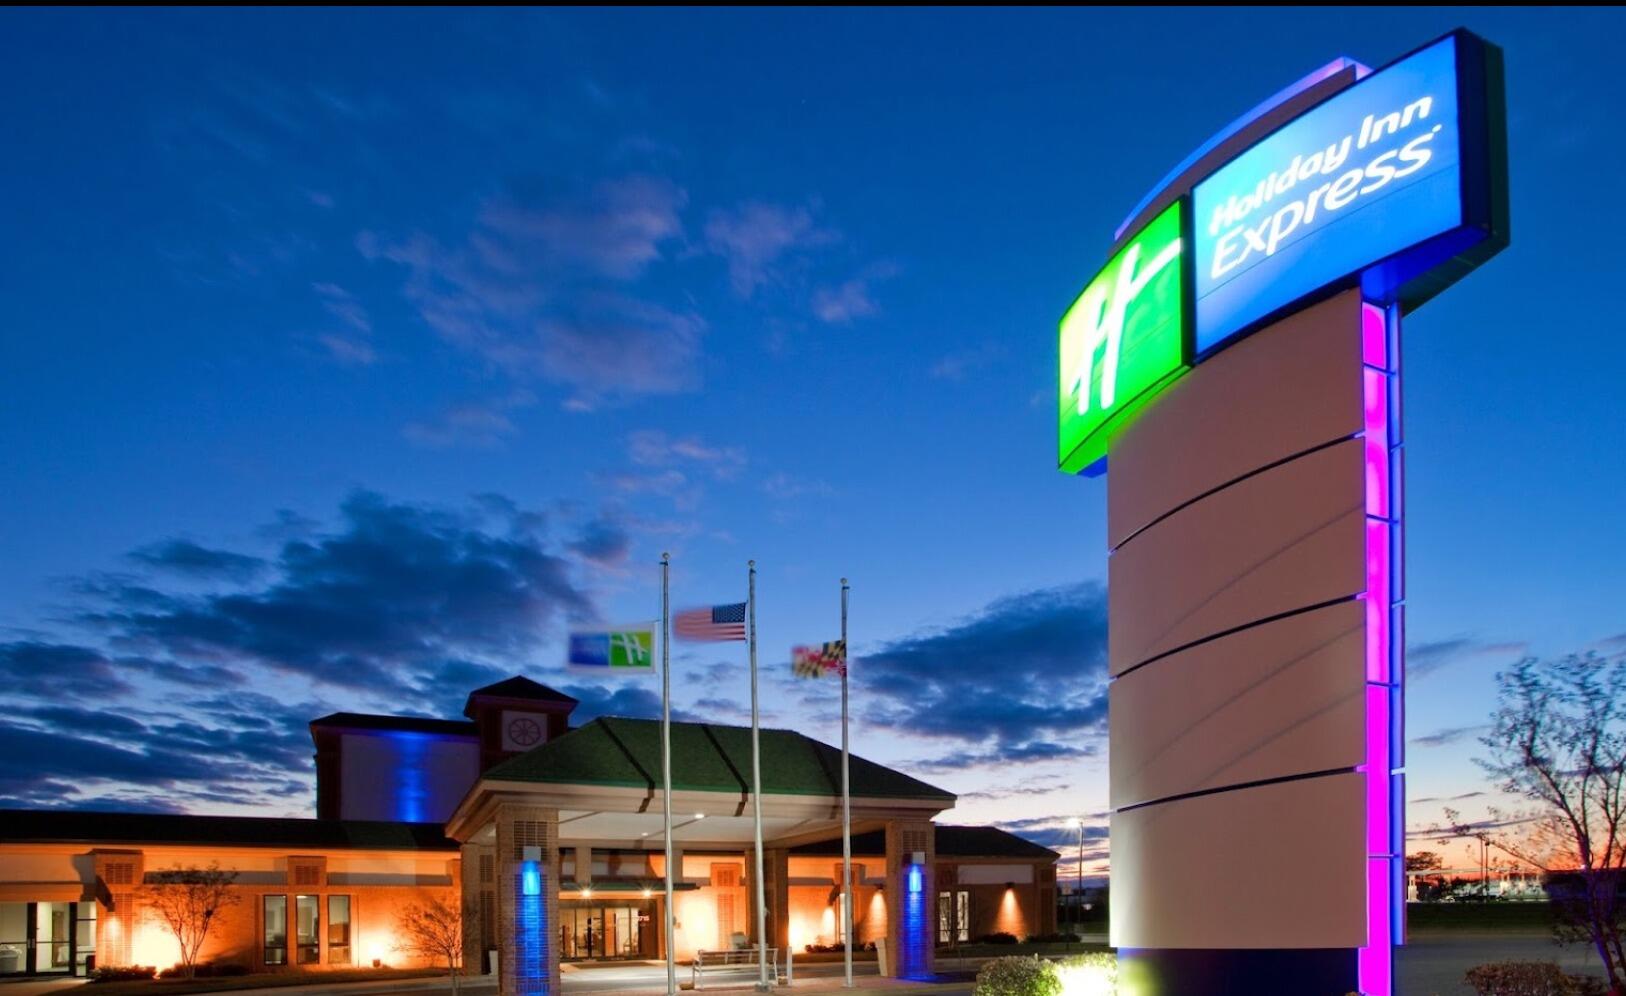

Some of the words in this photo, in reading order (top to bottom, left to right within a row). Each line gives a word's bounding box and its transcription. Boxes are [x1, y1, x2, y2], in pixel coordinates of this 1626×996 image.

[1208, 135, 1352, 236] Holiday
[1357, 96, 1433, 149] Inn
[1211, 130, 1435, 280] Express
